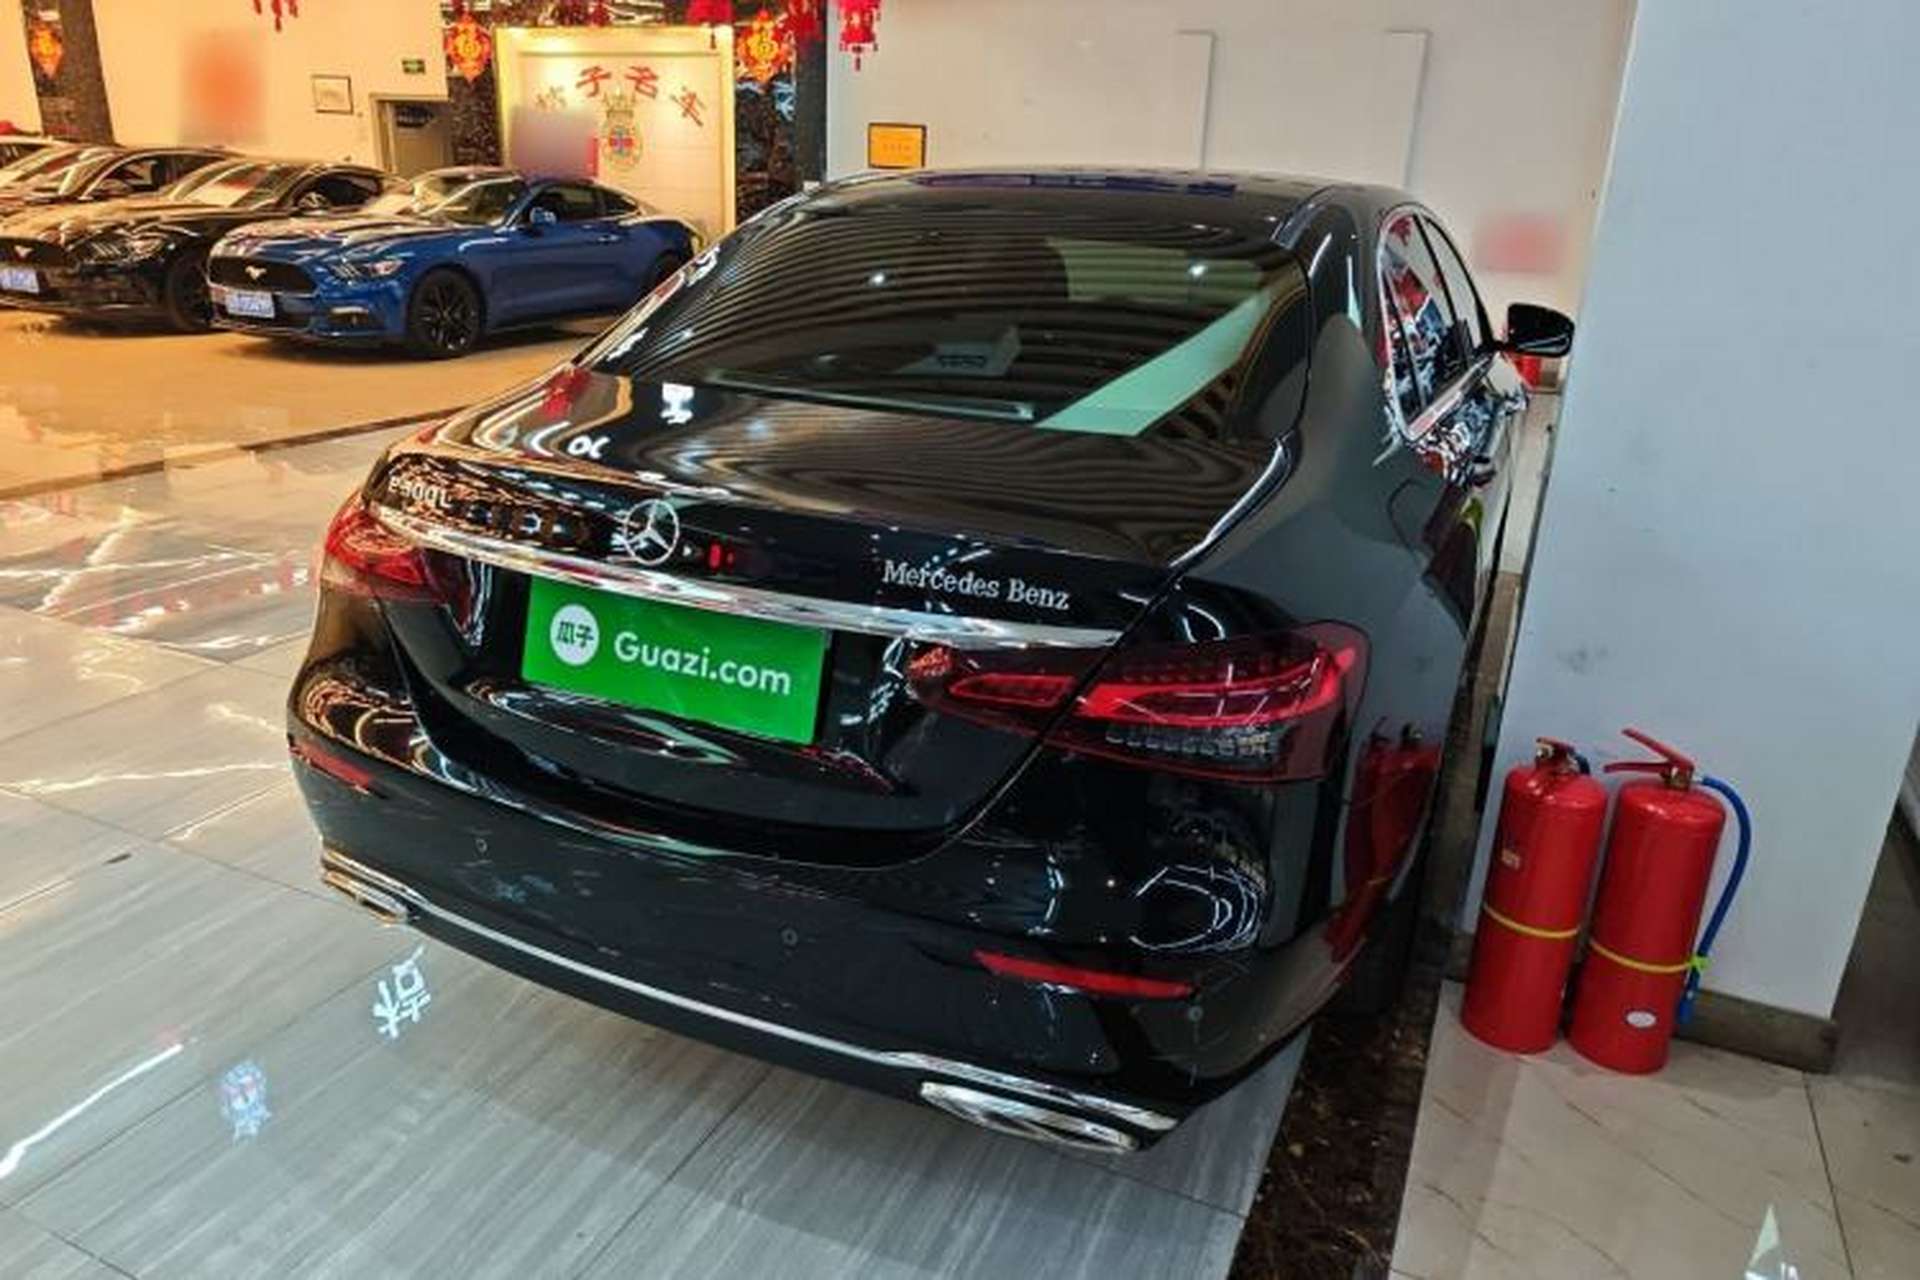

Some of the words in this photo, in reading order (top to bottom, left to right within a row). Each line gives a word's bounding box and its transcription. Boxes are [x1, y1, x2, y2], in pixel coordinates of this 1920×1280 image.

[881, 558, 1000, 599] Mercedes
[1006, 577, 1071, 611] Benz
[556, 620, 595, 649] 瓜子
[613, 630, 792, 697] Guazi.com
